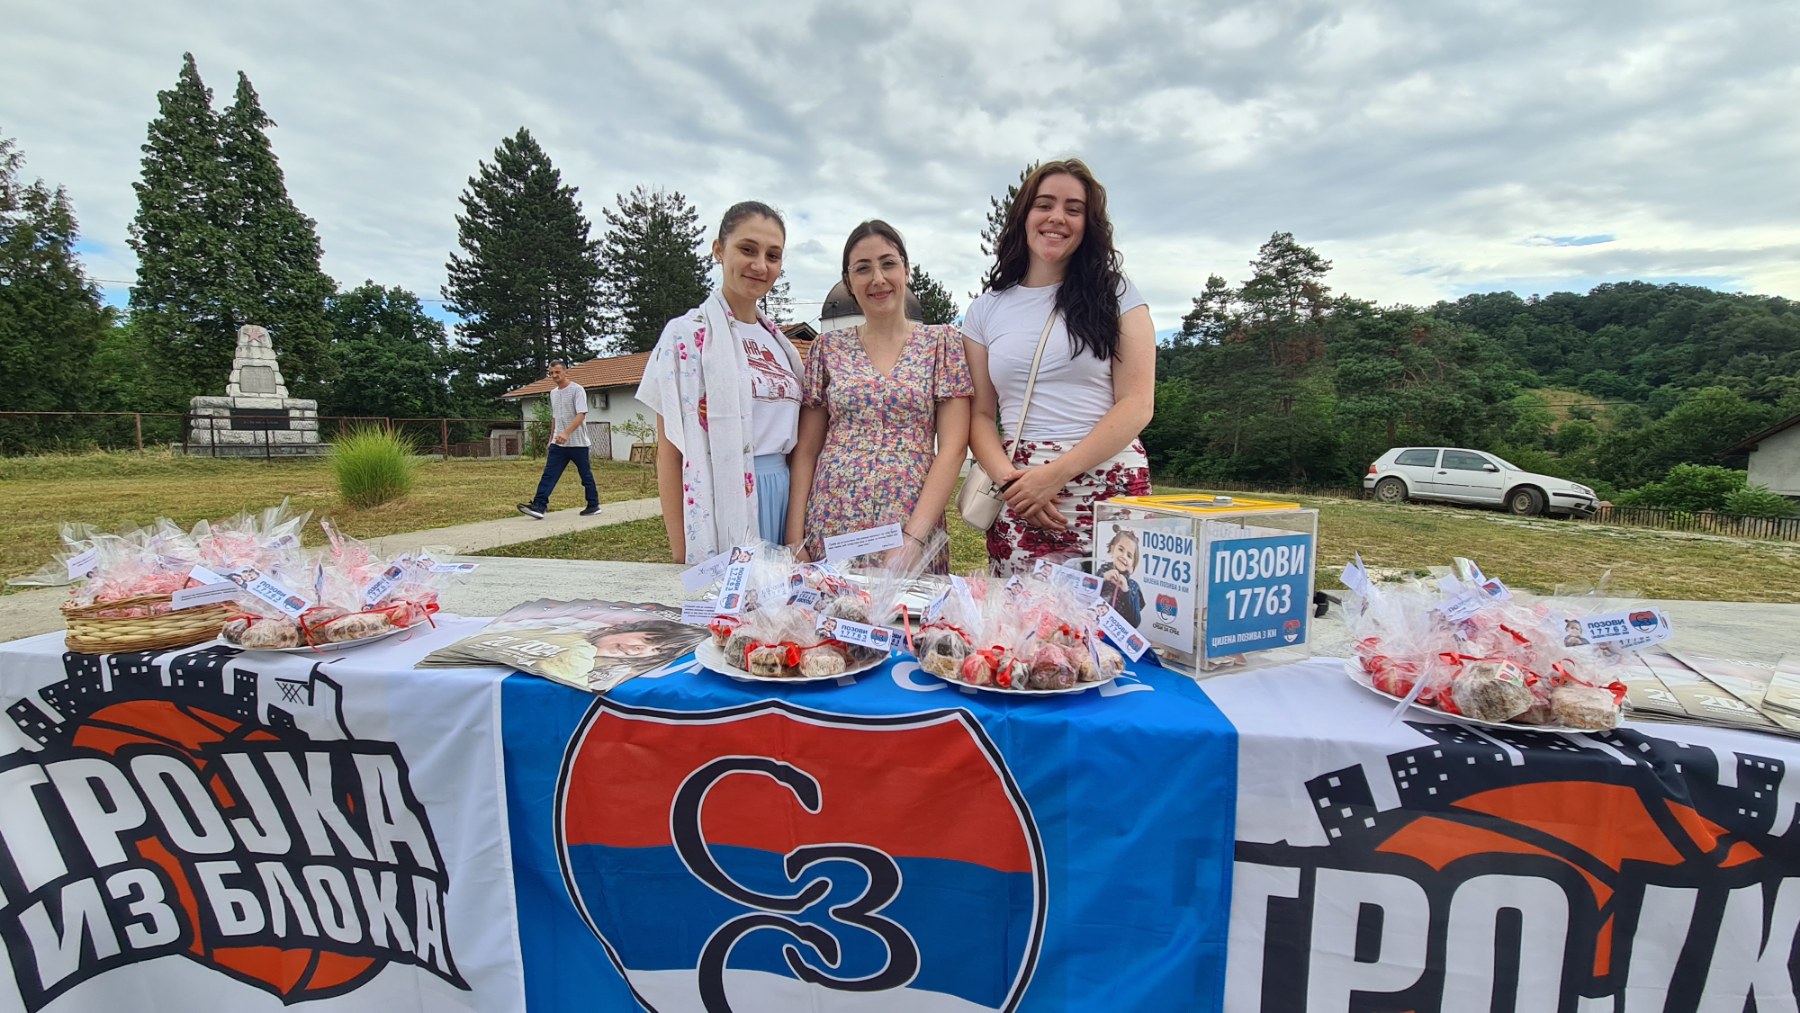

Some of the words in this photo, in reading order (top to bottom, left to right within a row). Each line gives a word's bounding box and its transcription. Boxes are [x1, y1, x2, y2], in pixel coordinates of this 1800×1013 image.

[1142, 531, 1193, 556] ПОЗОВИ
[1142, 553, 1191, 583] 17763
[1214, 545, 1305, 583] ПОЗОВИ
[1226, 584, 1292, 621] 17763
[841, 625, 868, 635] ПОЗОВИ
[1108, 615, 1129, 636] ПОЗОВИ
[1587, 619, 1625, 630] ПОЗОВИ
[1590, 625, 1628, 635] 17763
[1212, 635, 1236, 648] ЦИЈЕНА
[1237, 631, 1262, 642] ПОЗИВА
[1262, 630, 1266, 639] 3
[1267, 628, 1277, 638] КМ
[17, 868, 181, 991] ИЗ
[194, 860, 453, 976] БЛОКА
